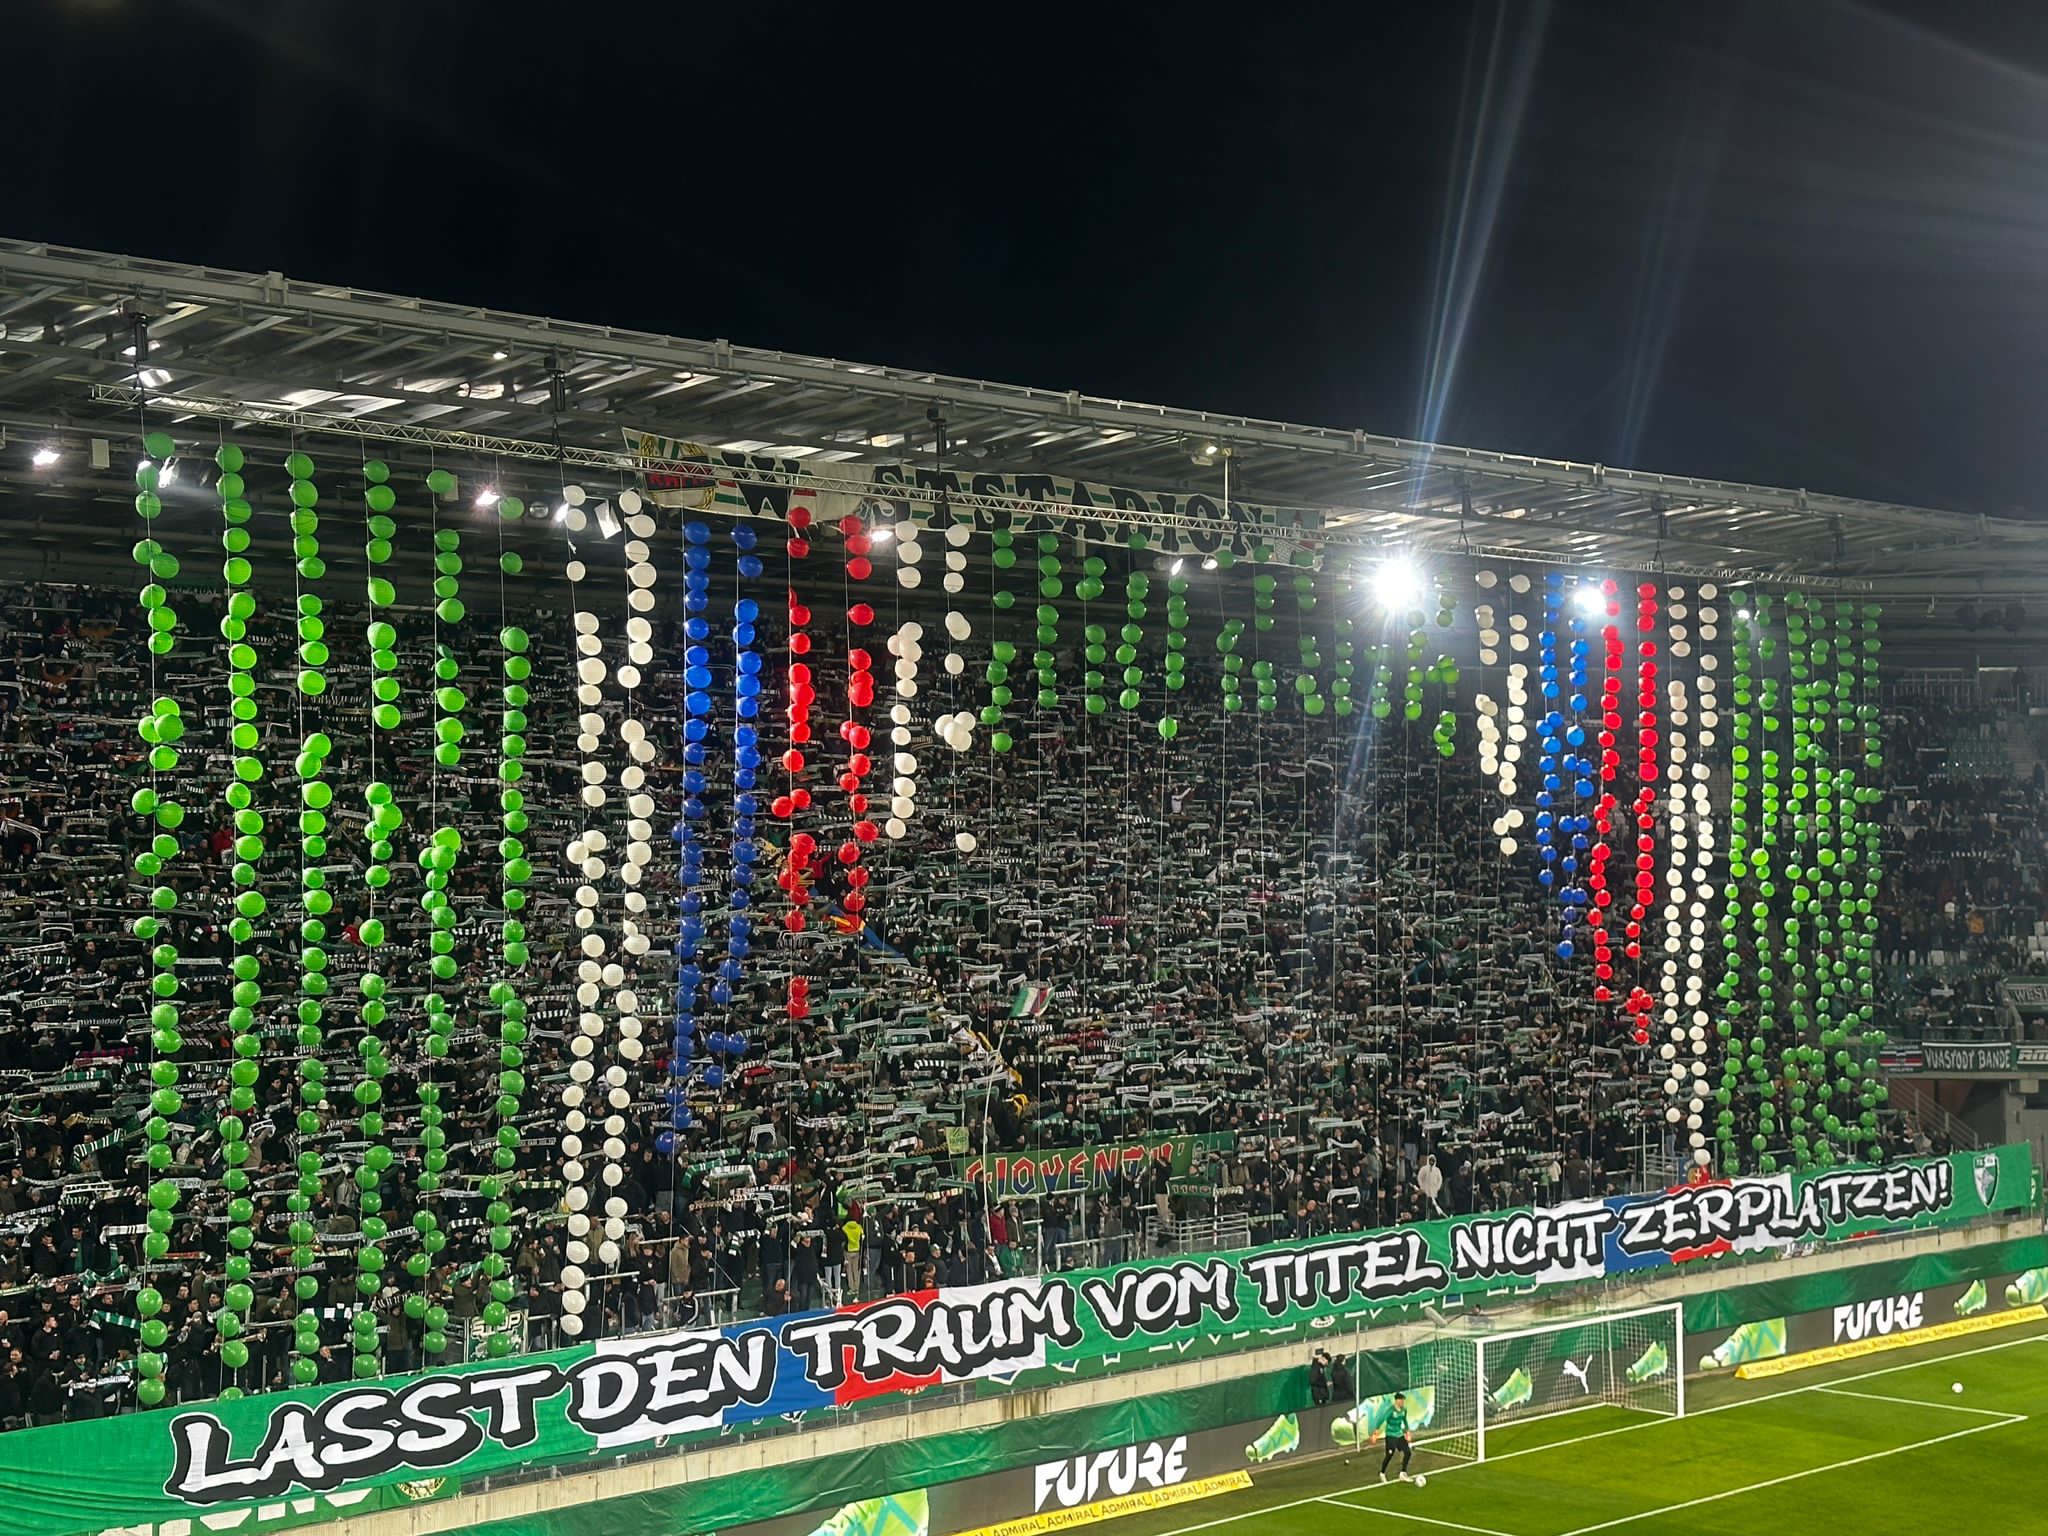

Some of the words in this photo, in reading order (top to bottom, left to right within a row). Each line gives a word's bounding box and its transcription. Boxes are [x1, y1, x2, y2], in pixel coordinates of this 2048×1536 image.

[1978, 1049, 2011, 1069] BANDE
[171, 1367, 560, 1499] LASST
[573, 1331, 770, 1425] DEN
[787, 1283, 1076, 1382] TRAUM
[1086, 1259, 1234, 1334] VOM
[1247, 1232, 1444, 1311] TITEL
[1453, 1211, 1614, 1274] NICHT
[1620, 1161, 1950, 1248] ZERPLATZEN!
[1833, 1291, 1924, 1343] FUTURE
[1034, 1436, 1188, 1513] FUTURE
[1047, 1509, 1099, 1526] ADMIRAL
[1101, 1496, 1152, 1516] ADMIRAL
[1155, 1484, 1202, 1503] ADMIRAL
[1204, 1474, 1249, 1494] ADMIRAL
